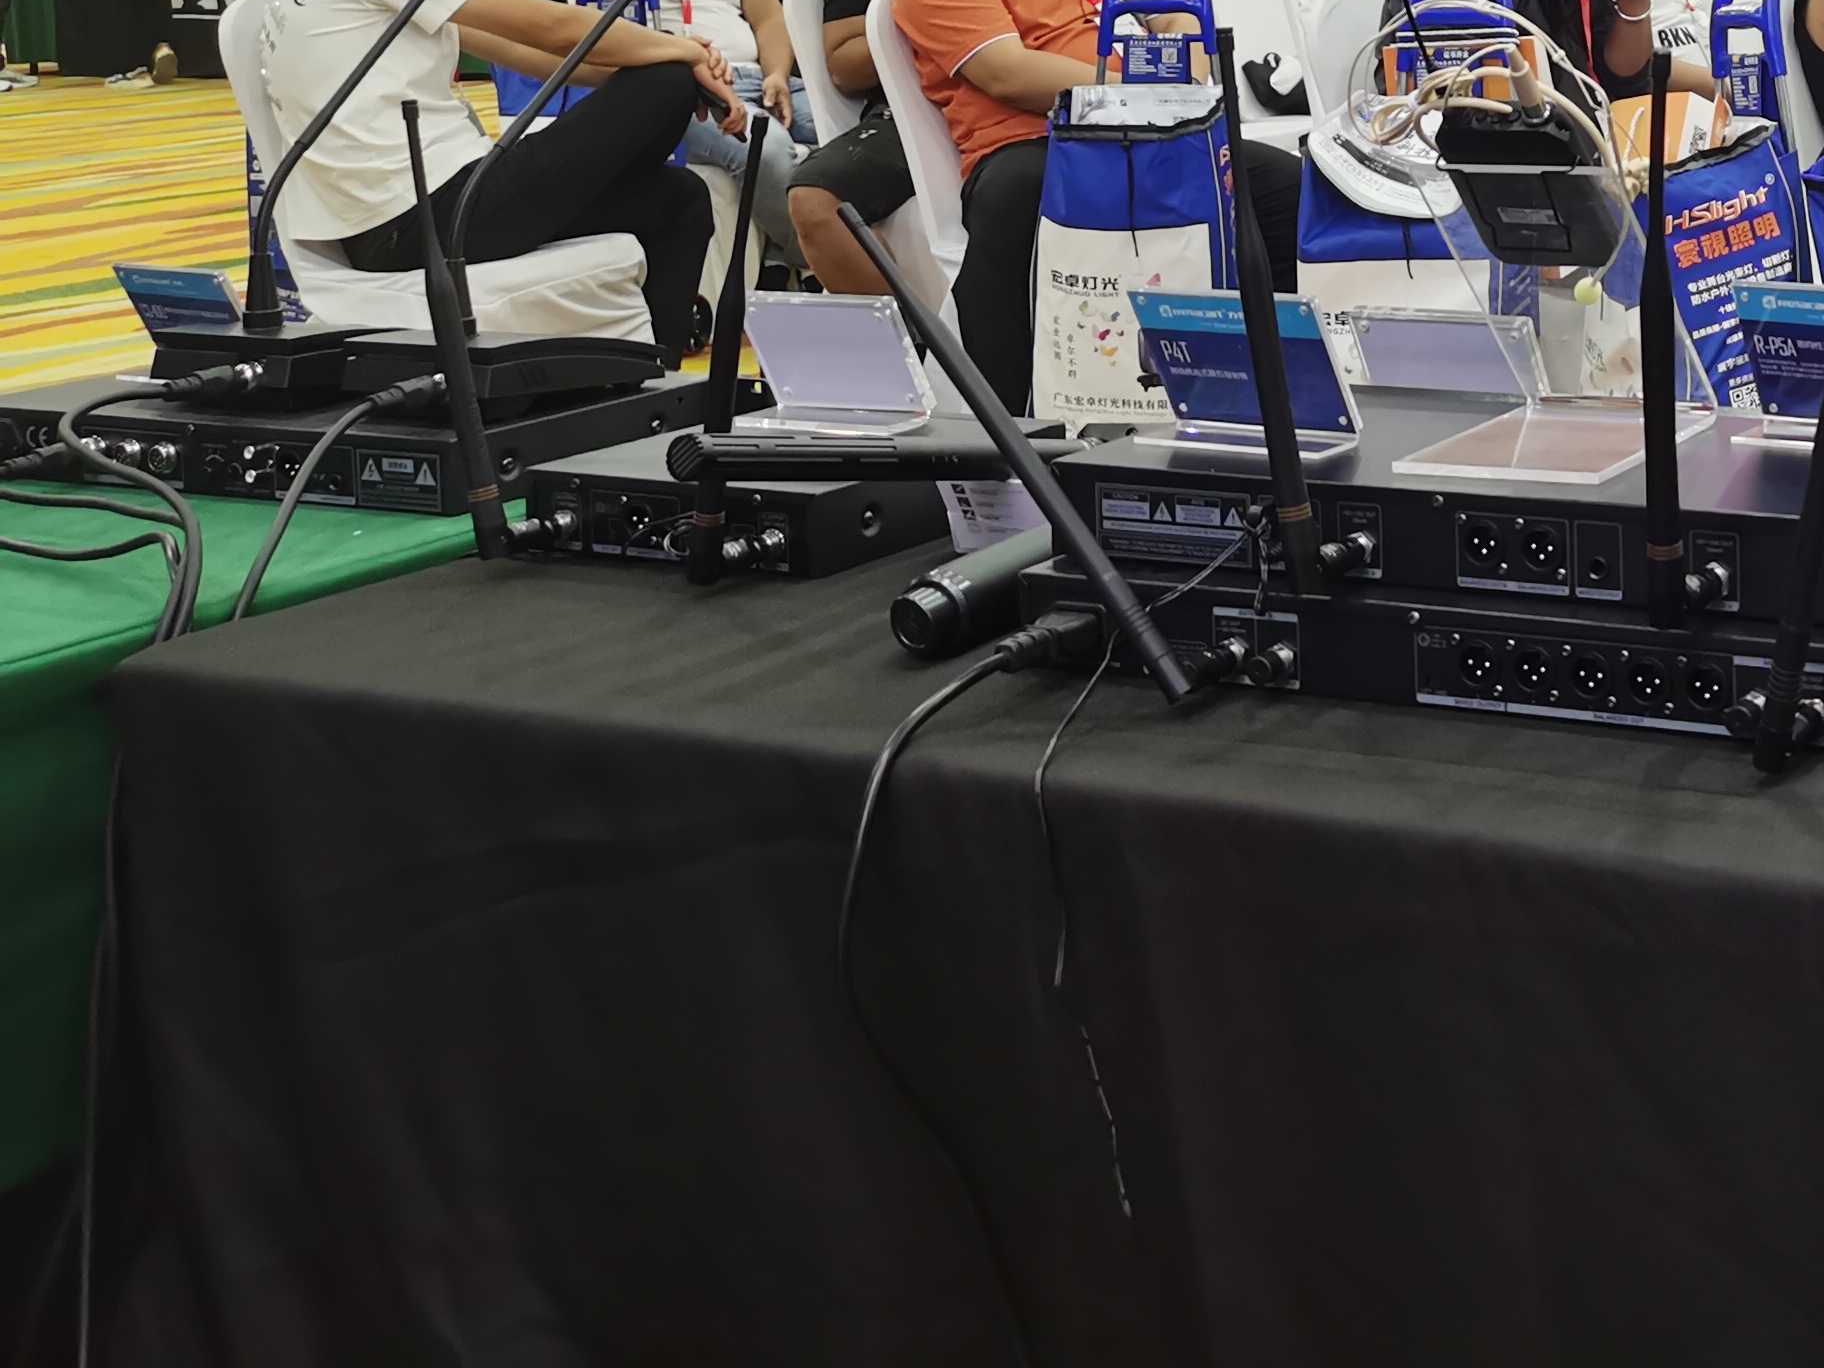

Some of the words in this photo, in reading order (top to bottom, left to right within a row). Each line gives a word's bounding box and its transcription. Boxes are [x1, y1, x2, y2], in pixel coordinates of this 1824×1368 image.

[1051, 269, 1120, 292] 宏卓灯光
[1159, 339, 1192, 364] P4T
